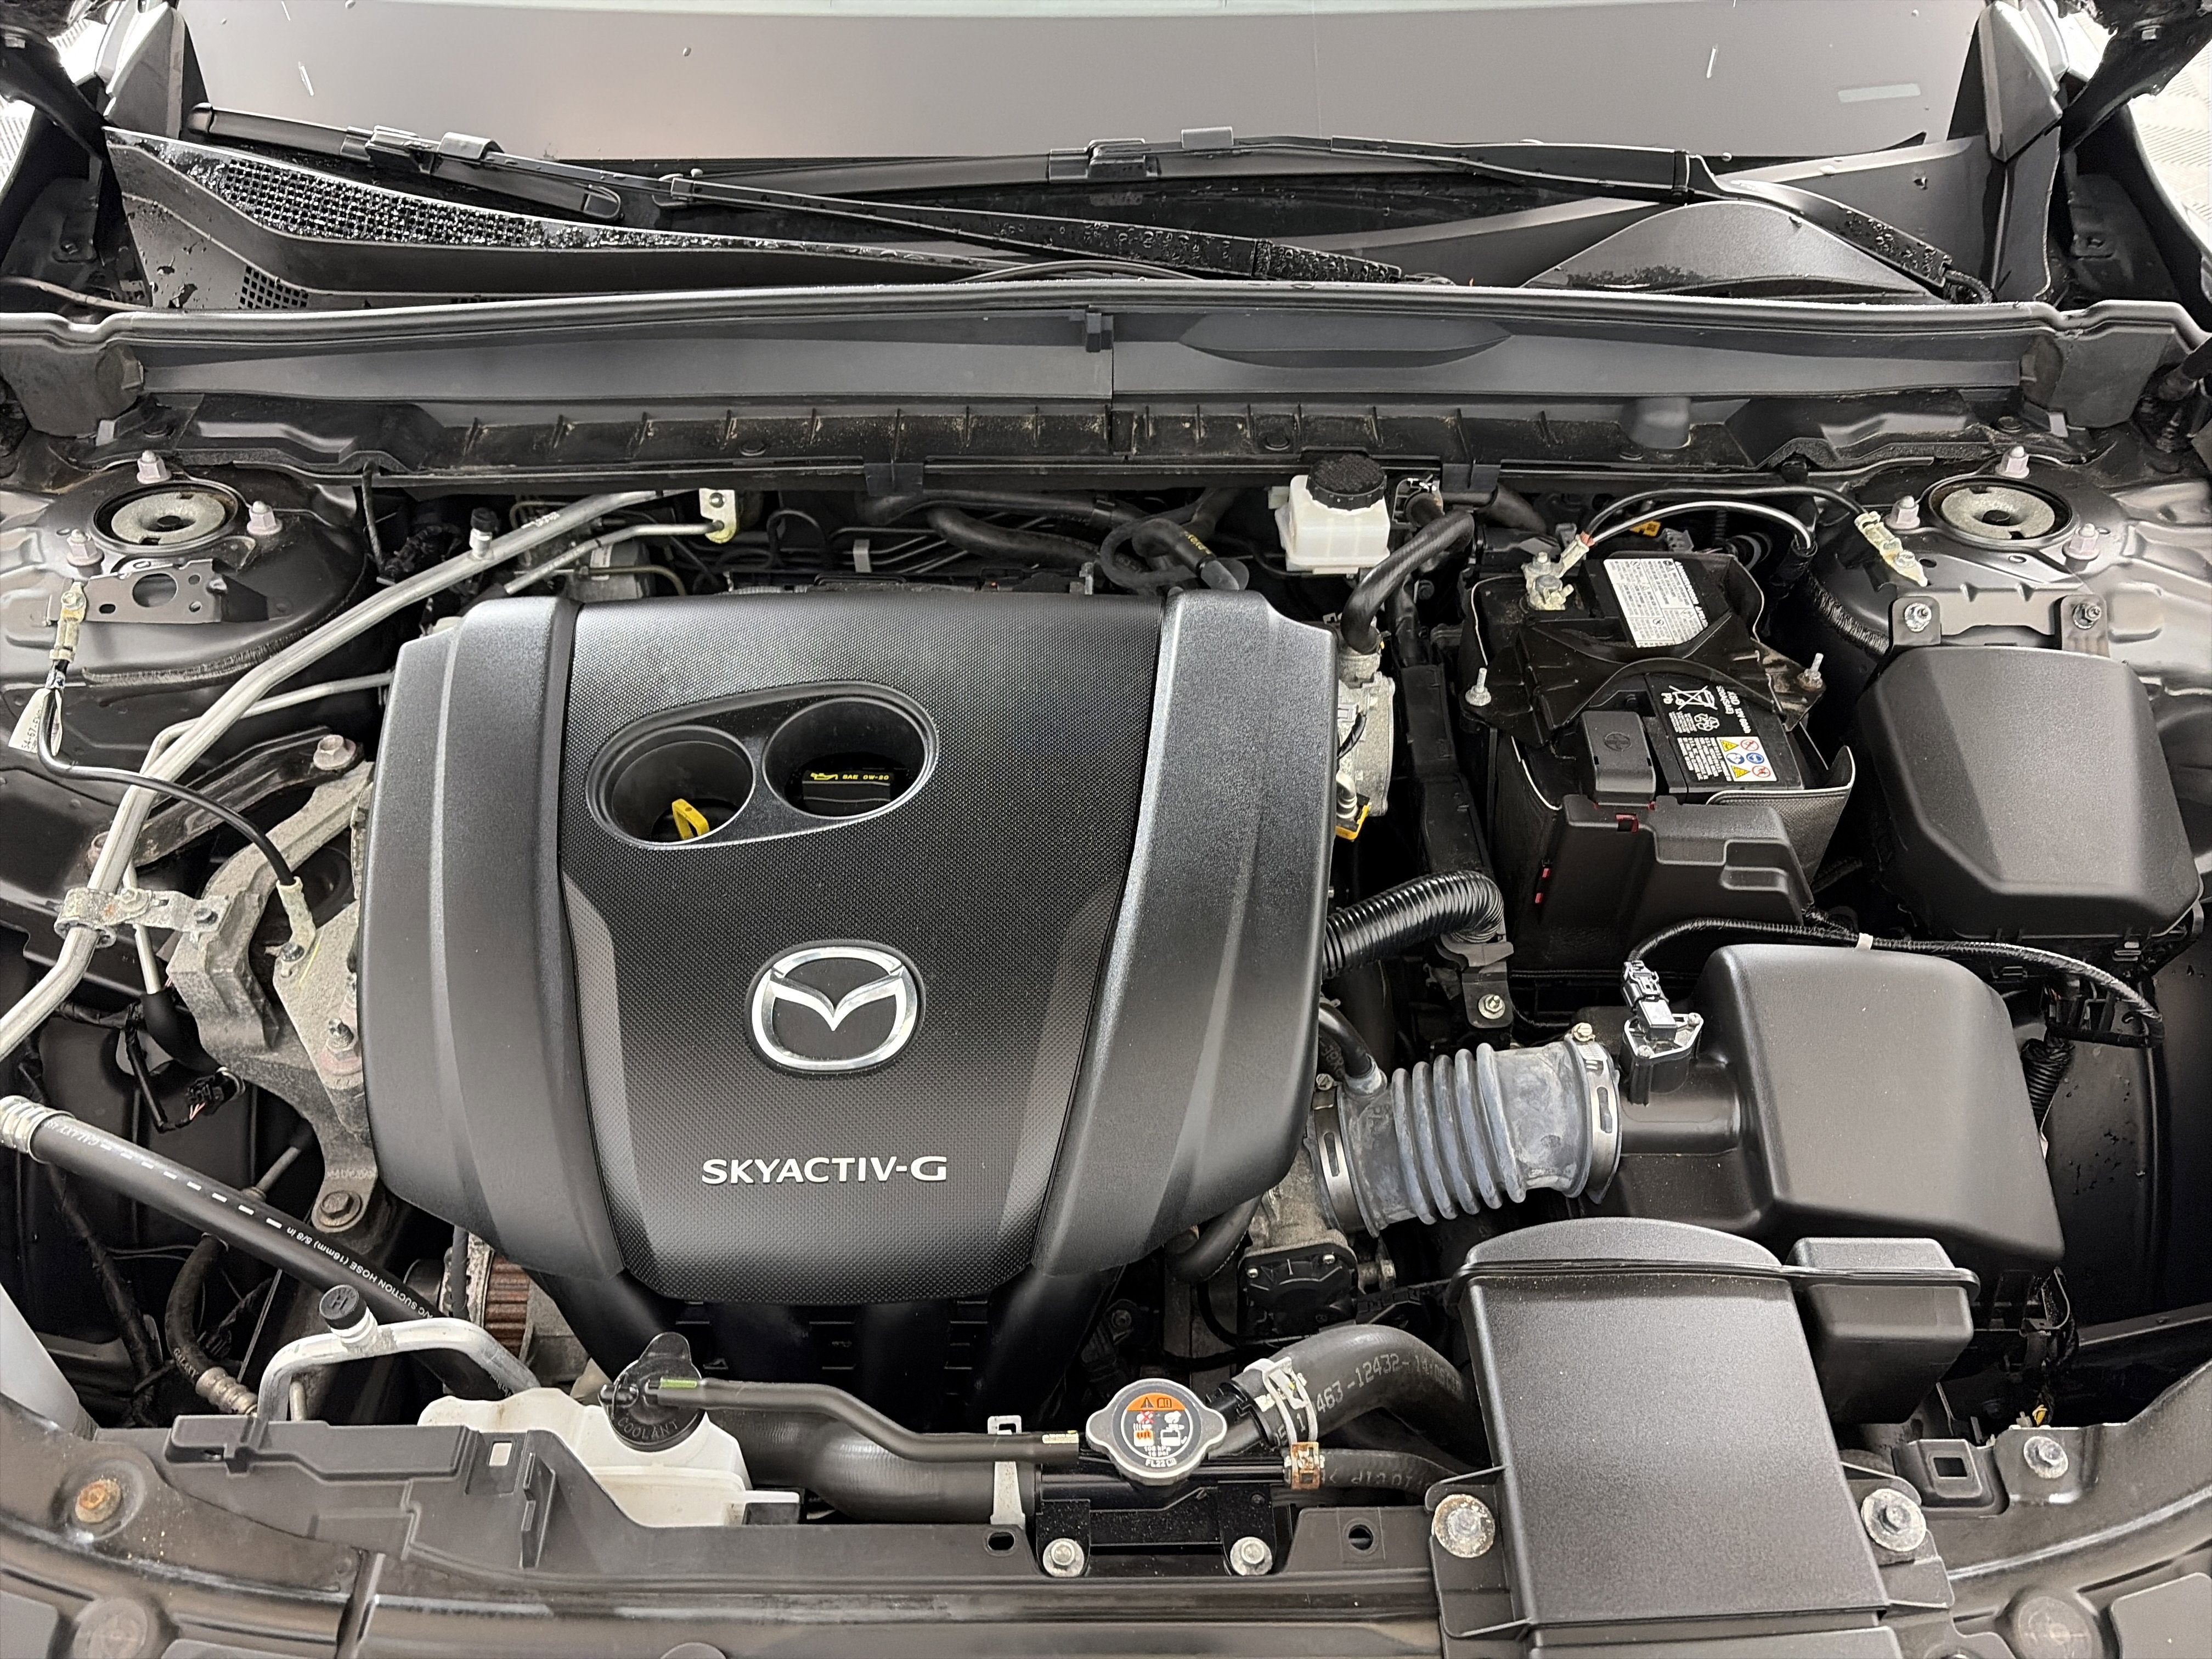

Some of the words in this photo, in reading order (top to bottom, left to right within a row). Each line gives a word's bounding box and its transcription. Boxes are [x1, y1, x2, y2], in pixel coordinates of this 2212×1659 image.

[1661, 692, 1673, 704] Pb
[702, 1156, 946, 1184] SKYACTIV-G
[286, 1226, 297, 1237] in
[296, 1232, 313, 1245] 5/8
[313, 1240, 349, 1266] (16mm)
[349, 1261, 378, 1283] HOSE
[377, 1279, 421, 1311] SUCTION
[618, 1416, 679, 1441] COOLANT
[1146, 1459, 1166, 1468] FL22
